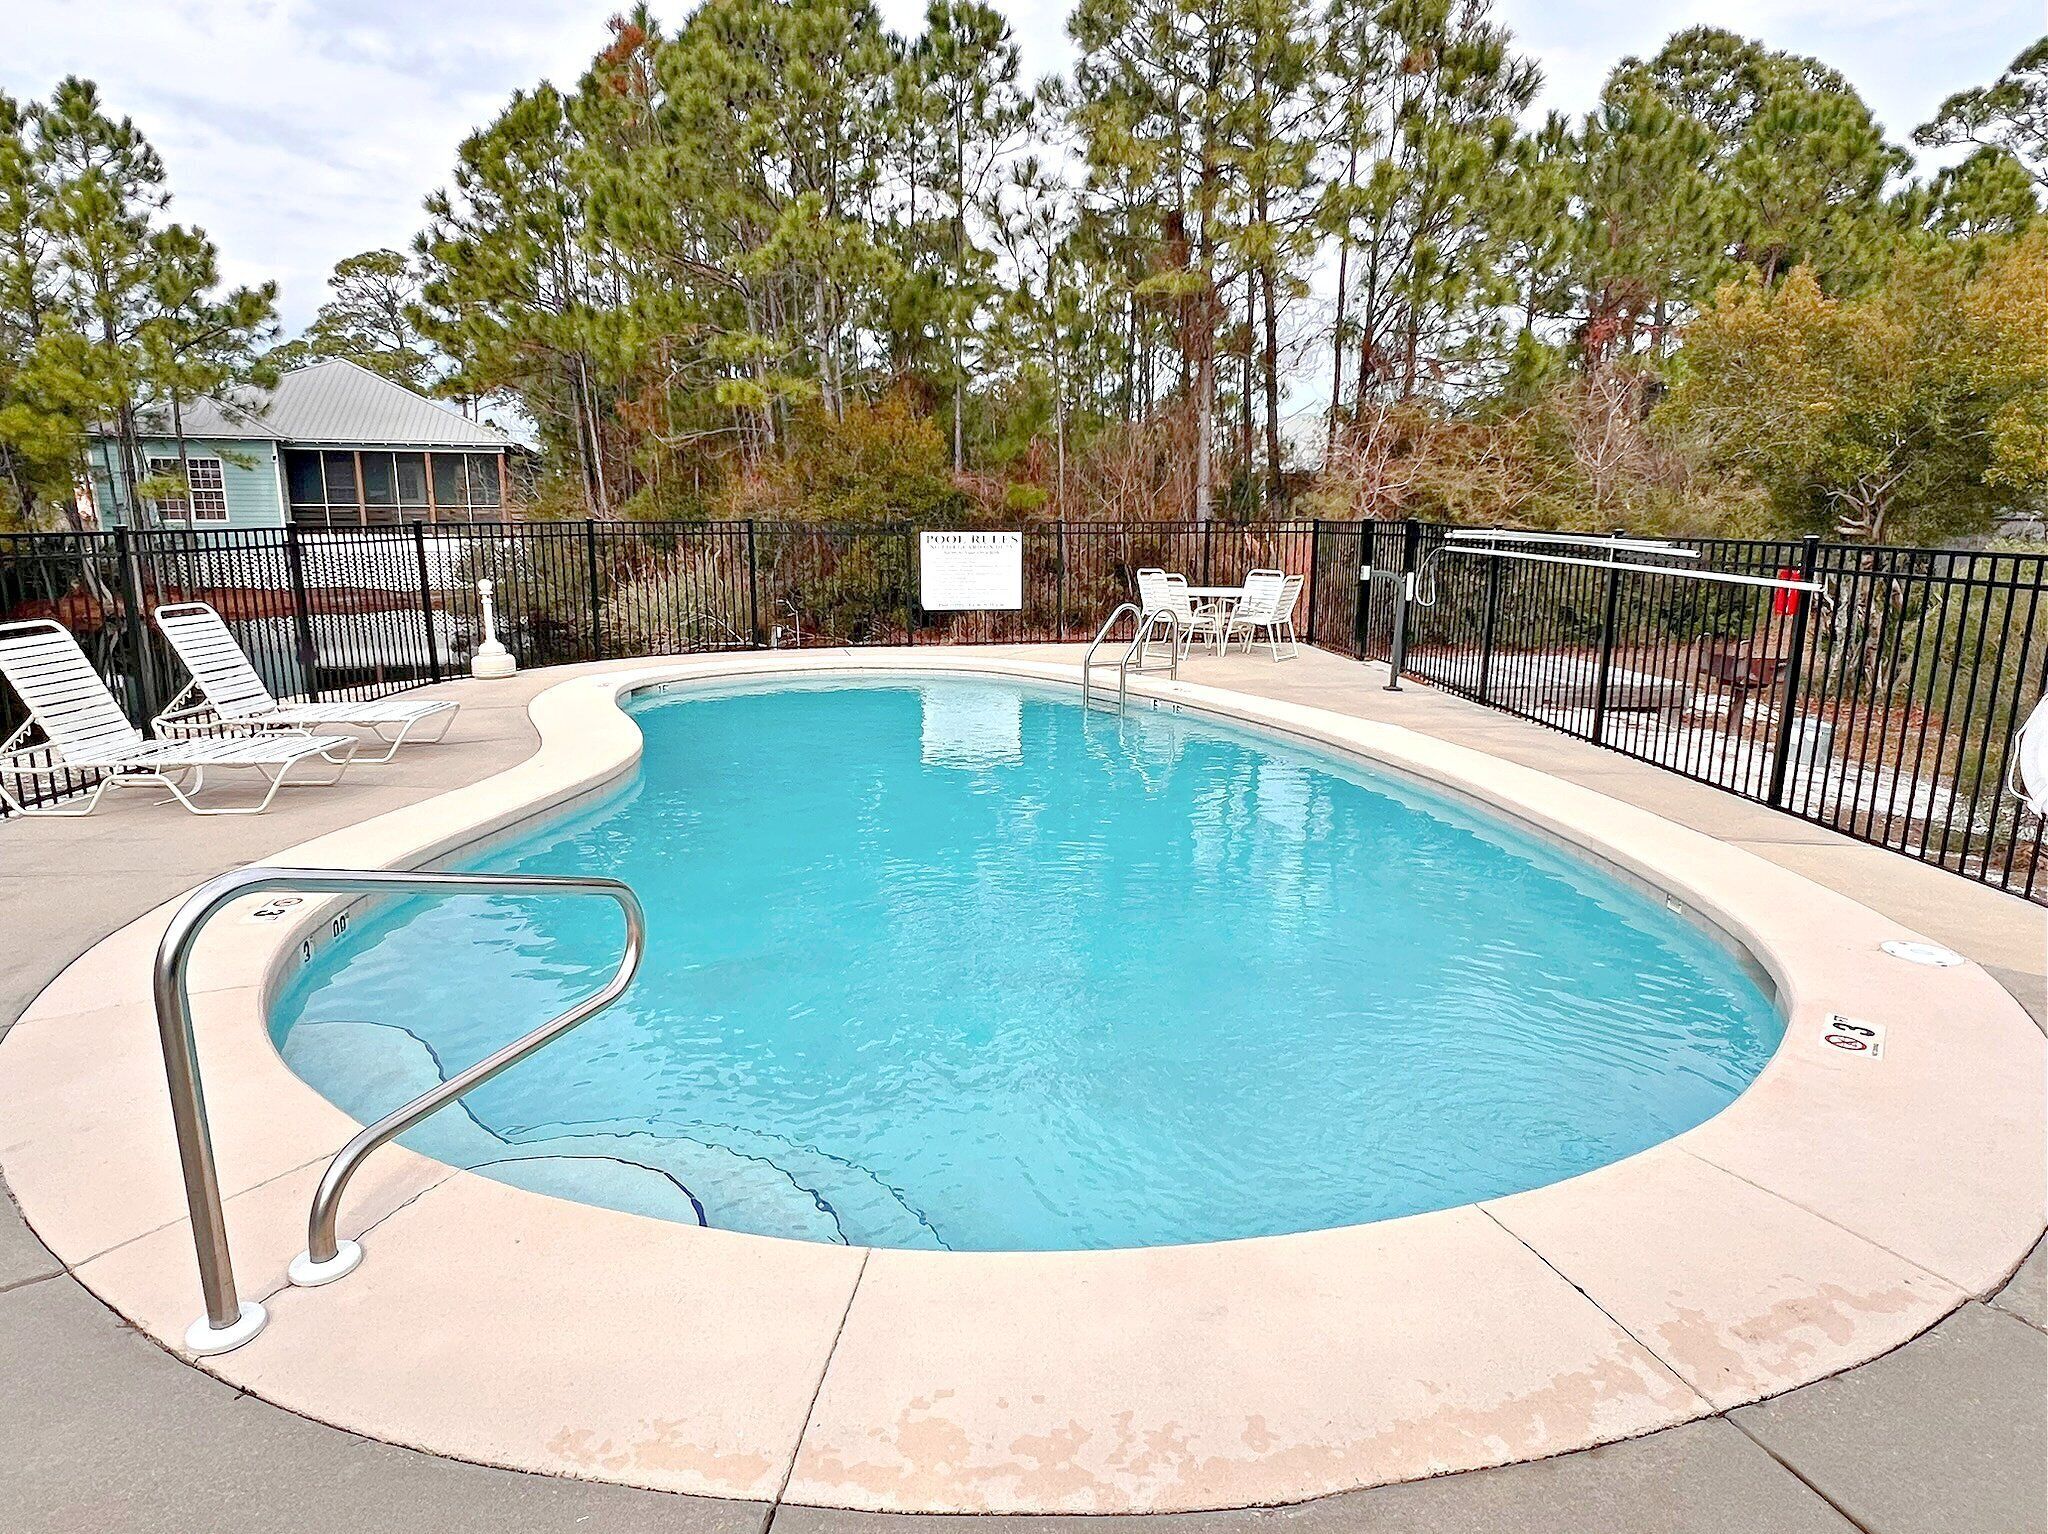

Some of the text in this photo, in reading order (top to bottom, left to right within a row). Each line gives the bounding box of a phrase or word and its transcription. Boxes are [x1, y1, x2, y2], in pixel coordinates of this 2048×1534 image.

[926, 535, 1019, 544] POOL RULES
[253, 909, 286, 917] 3
[303, 940, 311, 963] 3
[1832, 1022, 1876, 1037] 3
